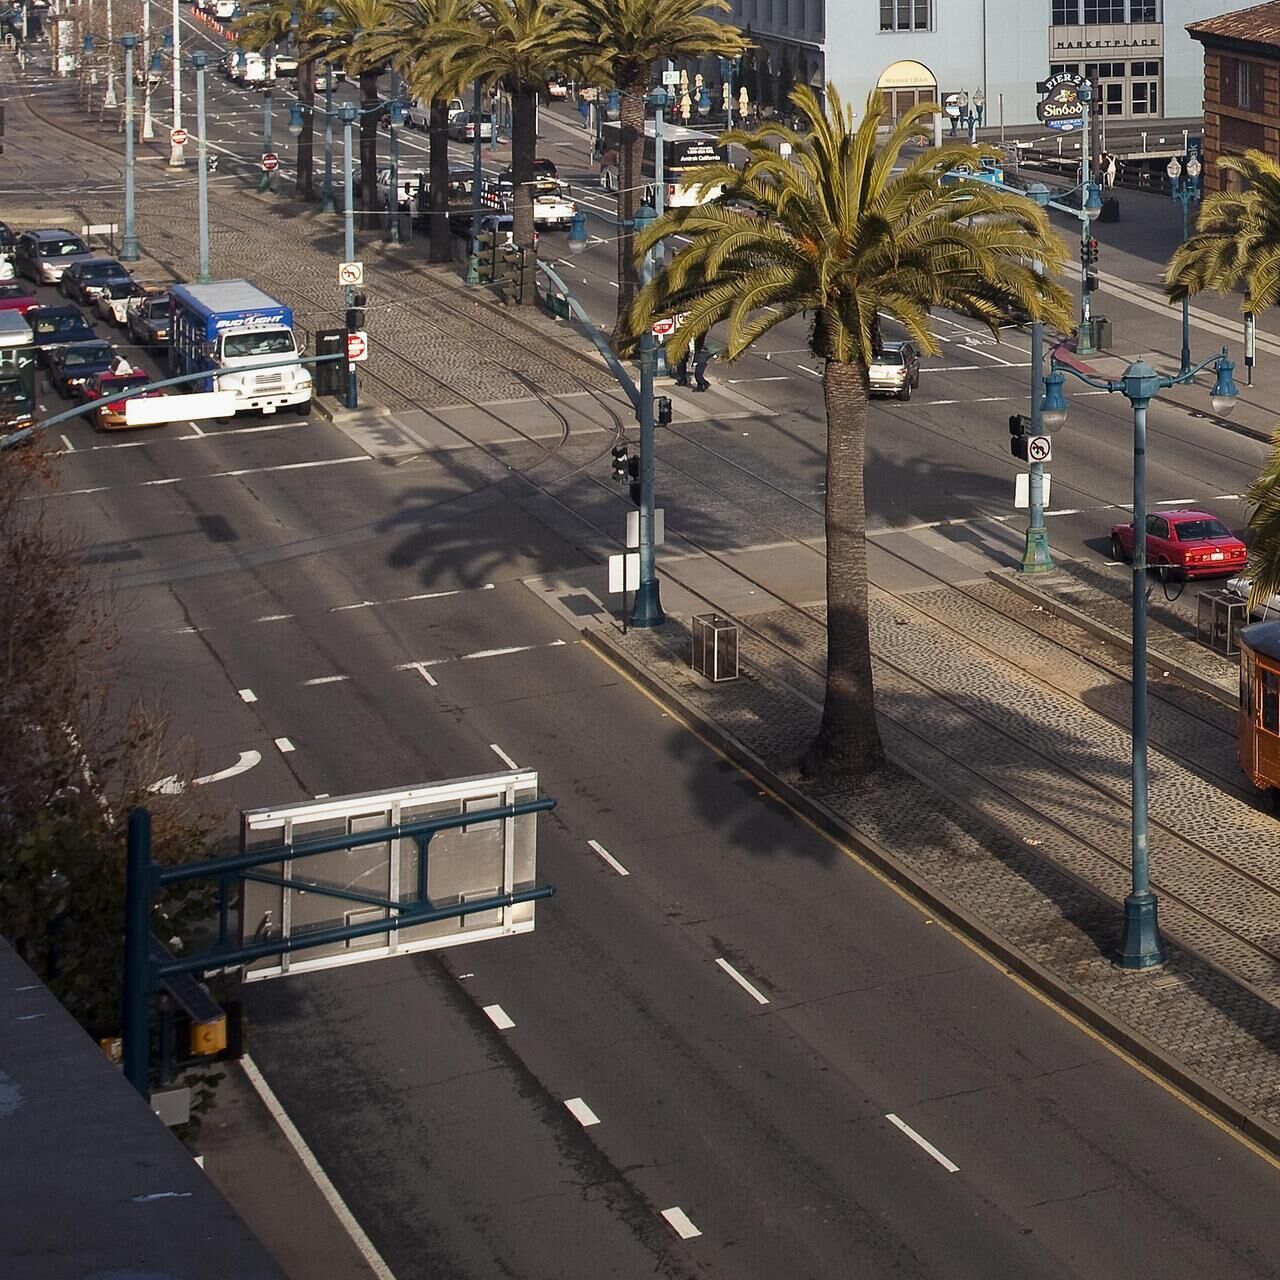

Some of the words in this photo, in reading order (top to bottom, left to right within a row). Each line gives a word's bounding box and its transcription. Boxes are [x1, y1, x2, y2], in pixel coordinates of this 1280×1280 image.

[1057, 39, 1159, 49] MARKETPLACE
[1045, 73, 1071, 90] PIER
[1043, 102, 1089, 116] Sinbad
[216, 319, 244, 328] BUD
